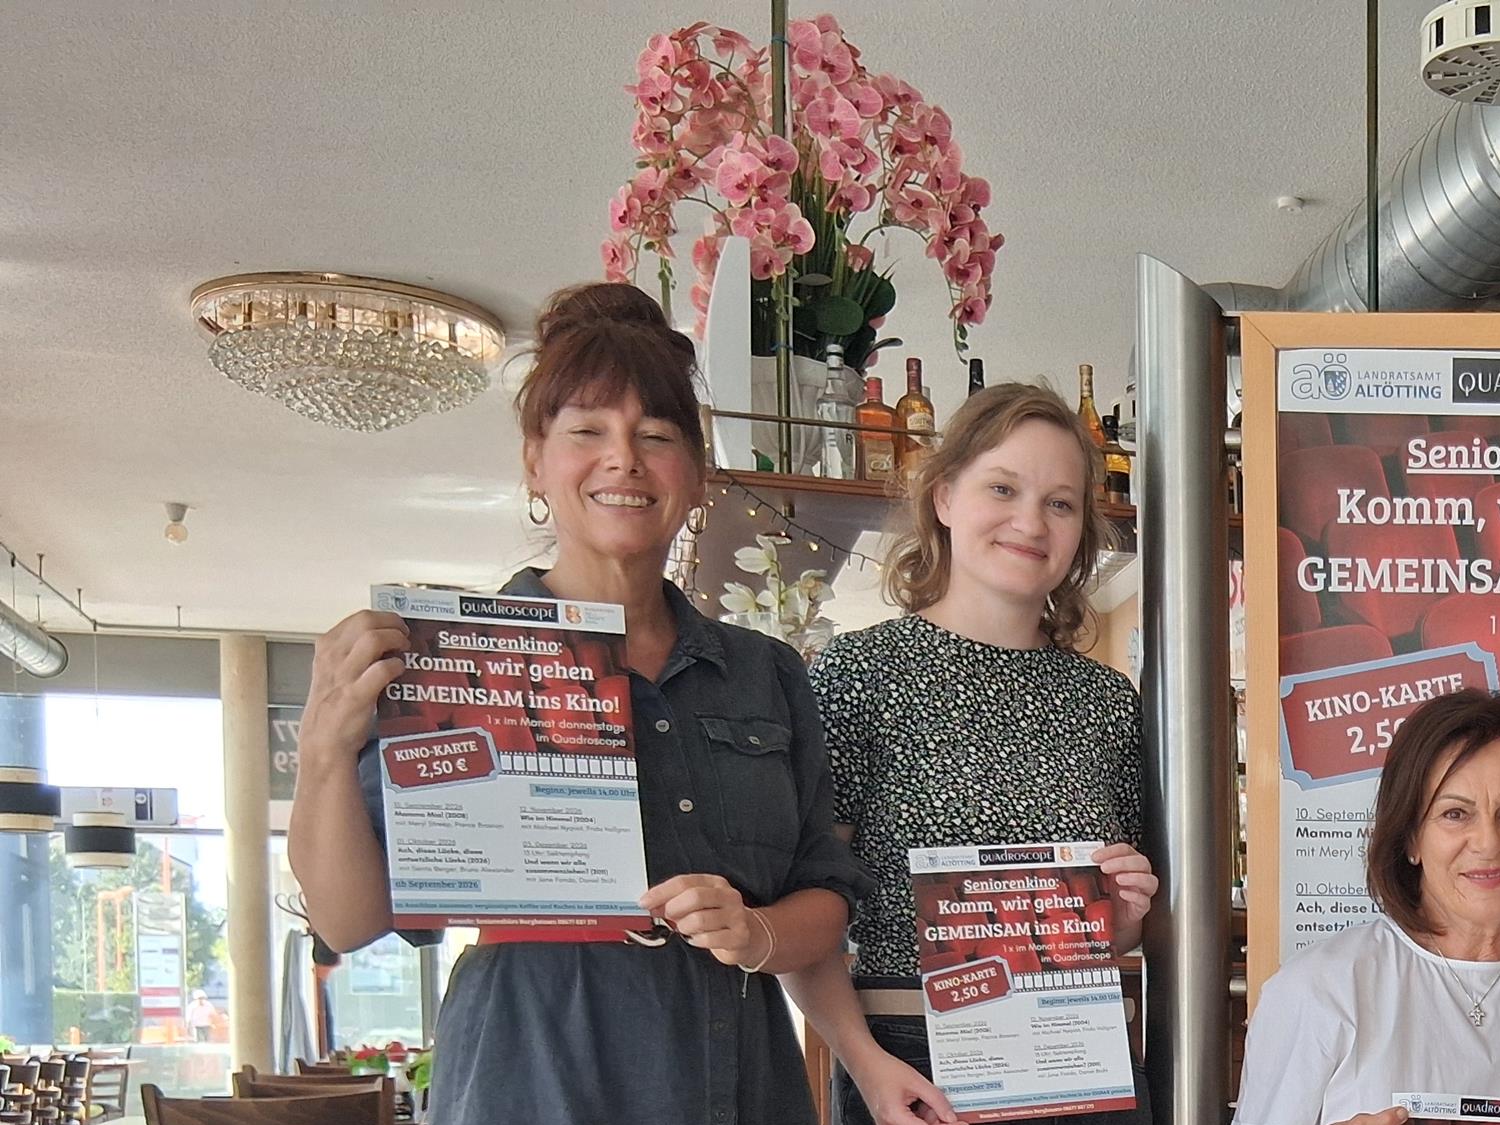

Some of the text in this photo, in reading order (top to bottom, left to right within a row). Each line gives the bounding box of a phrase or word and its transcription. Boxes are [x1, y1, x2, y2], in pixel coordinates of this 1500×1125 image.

[1357, 370, 1442, 381] LANDRATSAMT
[1354, 381, 1442, 400] ALTÖTTING
[1336, 488, 1486, 533] Komm,
[1489, 616, 1497, 635] 1
[438, 630, 563, 655] Seniorenkino:
[404, 653, 594, 682] Komm, wir gehen
[386, 683, 620, 713] GEMEINSAM ins Kino!
[1304, 672, 1465, 723] KINO-KARTE
[559, 720, 625, 734] donnerstags
[395, 741, 478, 762] KINO-KARTE
[417, 758, 468, 778] 2,50 €
[1295, 807, 1375, 823] 10. Septemb
[1295, 827, 1352, 838] Mamma
[1295, 846, 1315, 857] mit
[1319, 845, 1353, 861] Meryl
[964, 878, 1060, 894] Seniorenkino:
[1295, 882, 1368, 895] 01. Oktober
[938, 896, 1084, 915] Komm, wir gehen
[1295, 901, 1326, 915] Ach,
[1330, 901, 1367, 914] diese
[925, 918, 1105, 940] GEMEINSAM ins Kino!
[933, 967, 998, 991] KINO-KARTE
[951, 984, 990, 1002] 2,50 €
